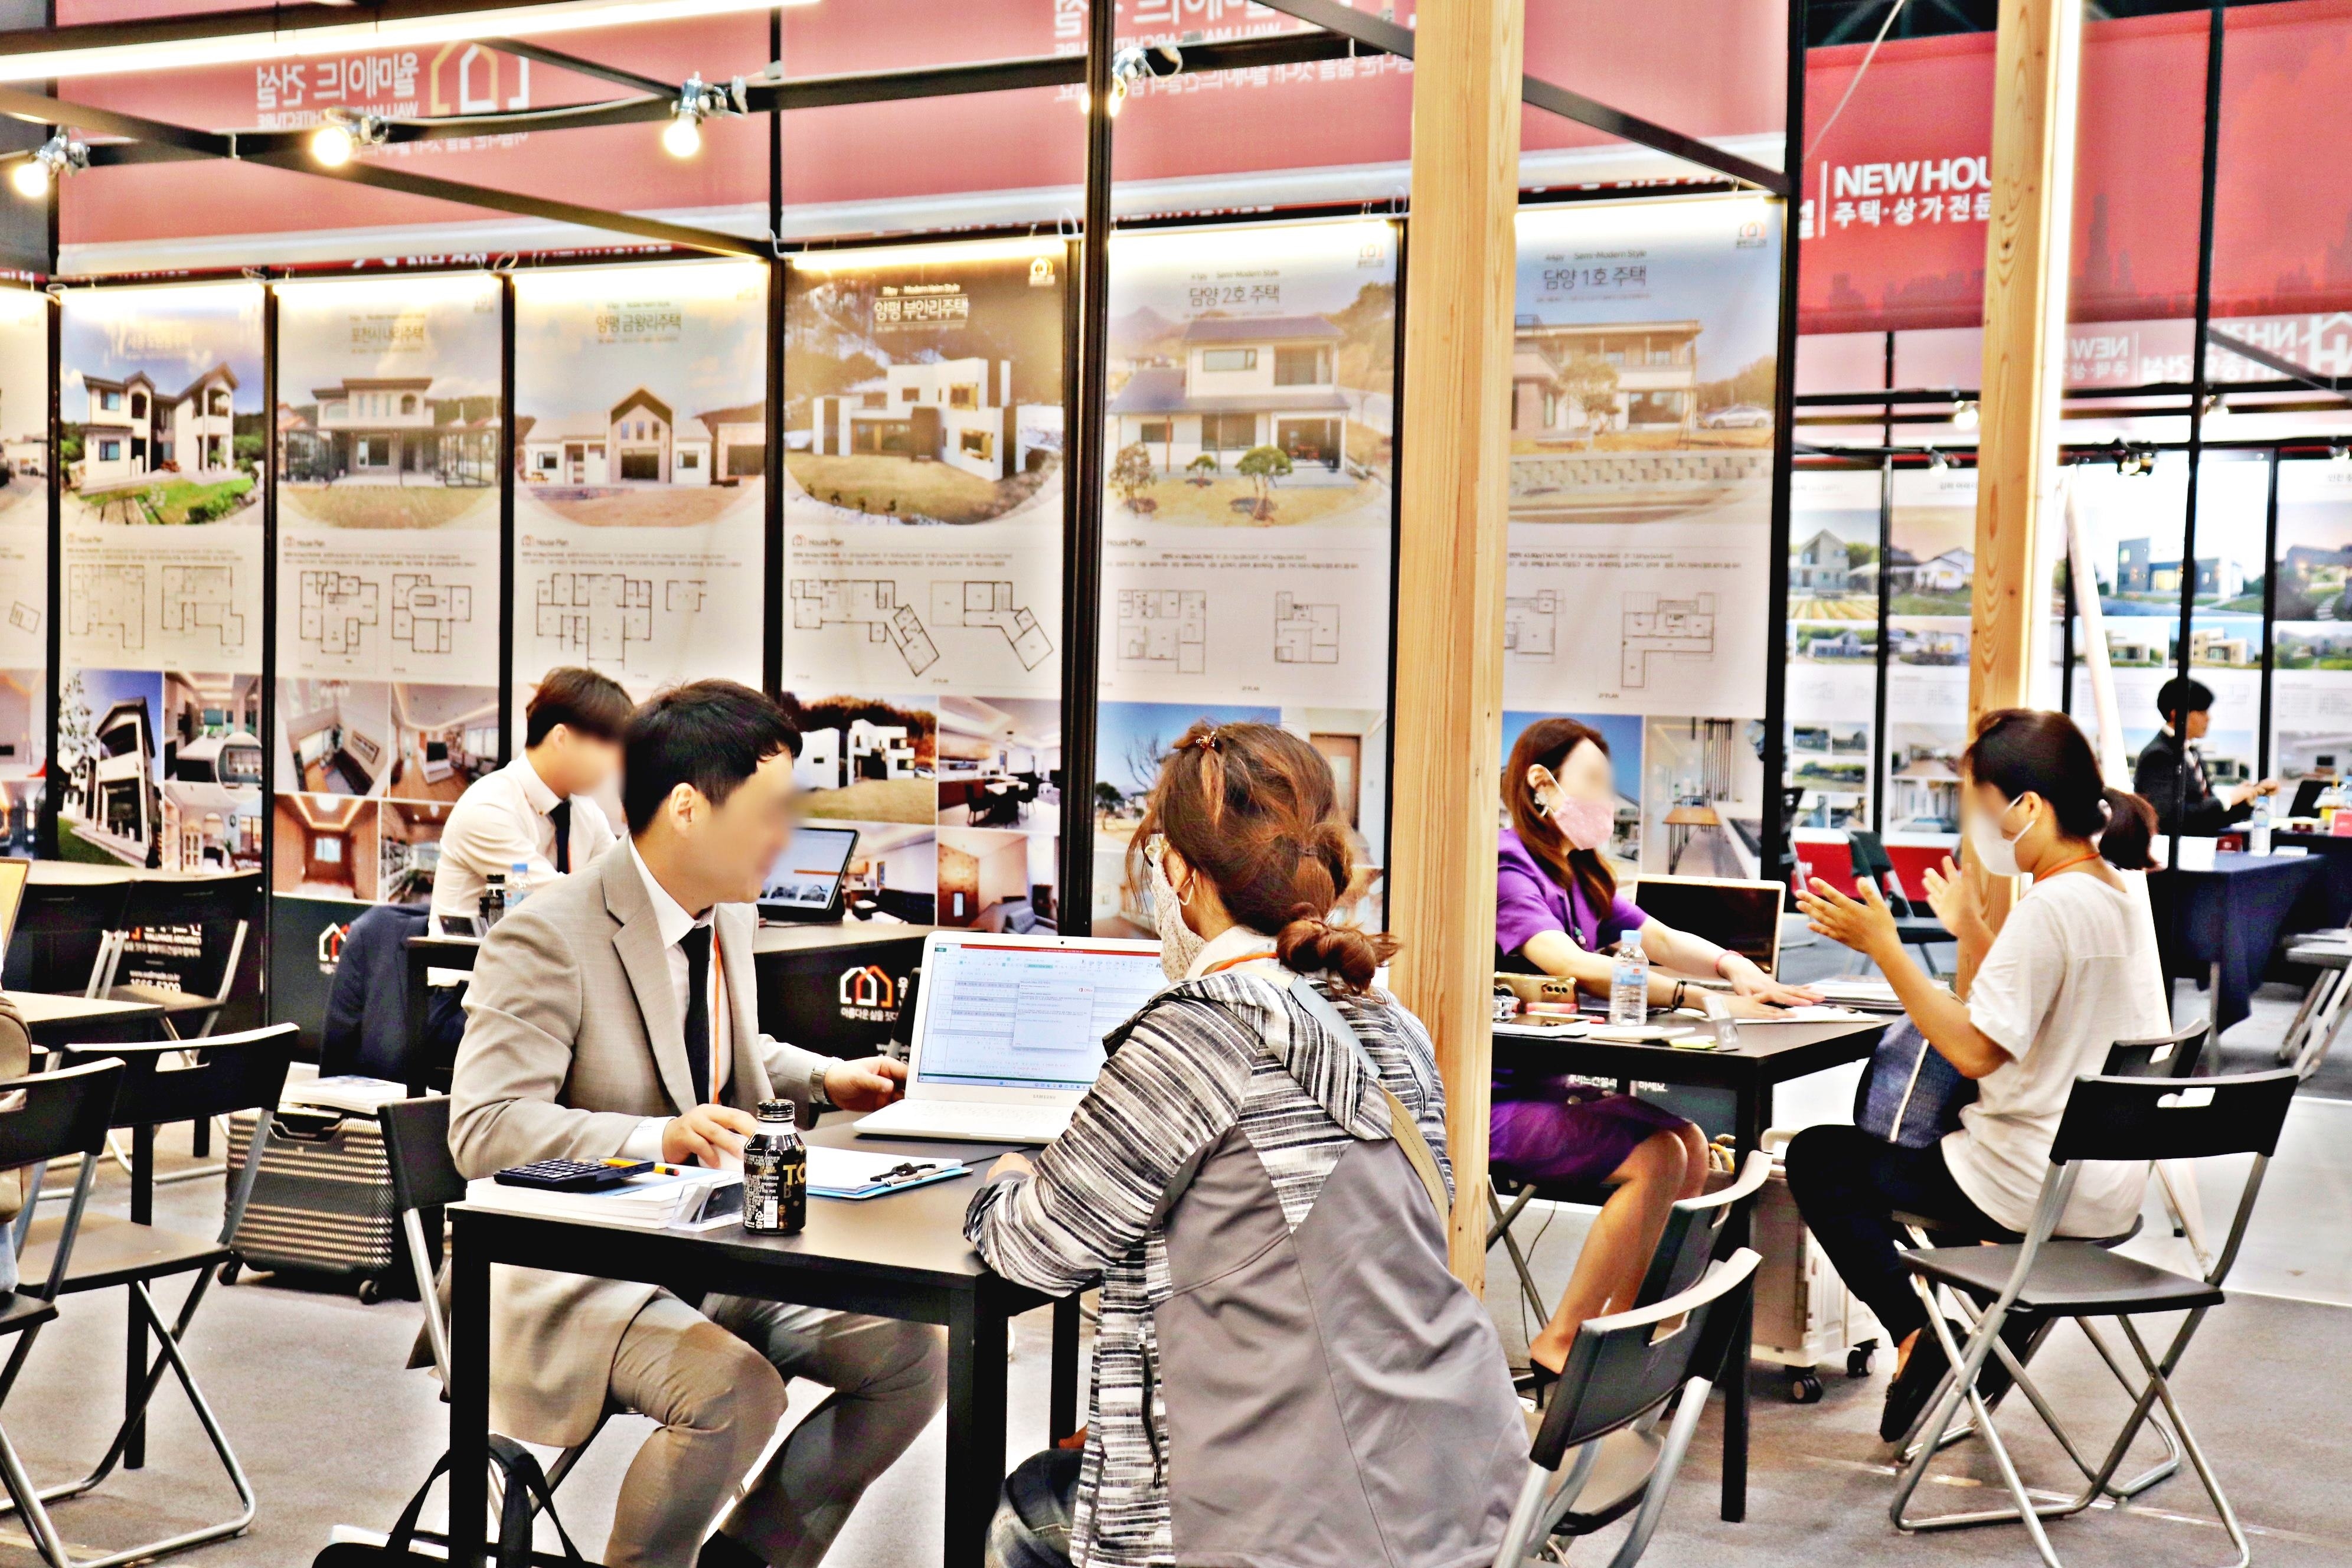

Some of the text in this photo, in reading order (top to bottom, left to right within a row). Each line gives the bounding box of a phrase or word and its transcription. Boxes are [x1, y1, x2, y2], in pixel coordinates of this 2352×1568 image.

[1833, 161, 1920, 198] NEW
[1544, 265, 1647, 290] 담양 1호 주택
[1190, 283, 1280, 306] 담양 2호 주택
[874, 300, 901, 324] 양평
